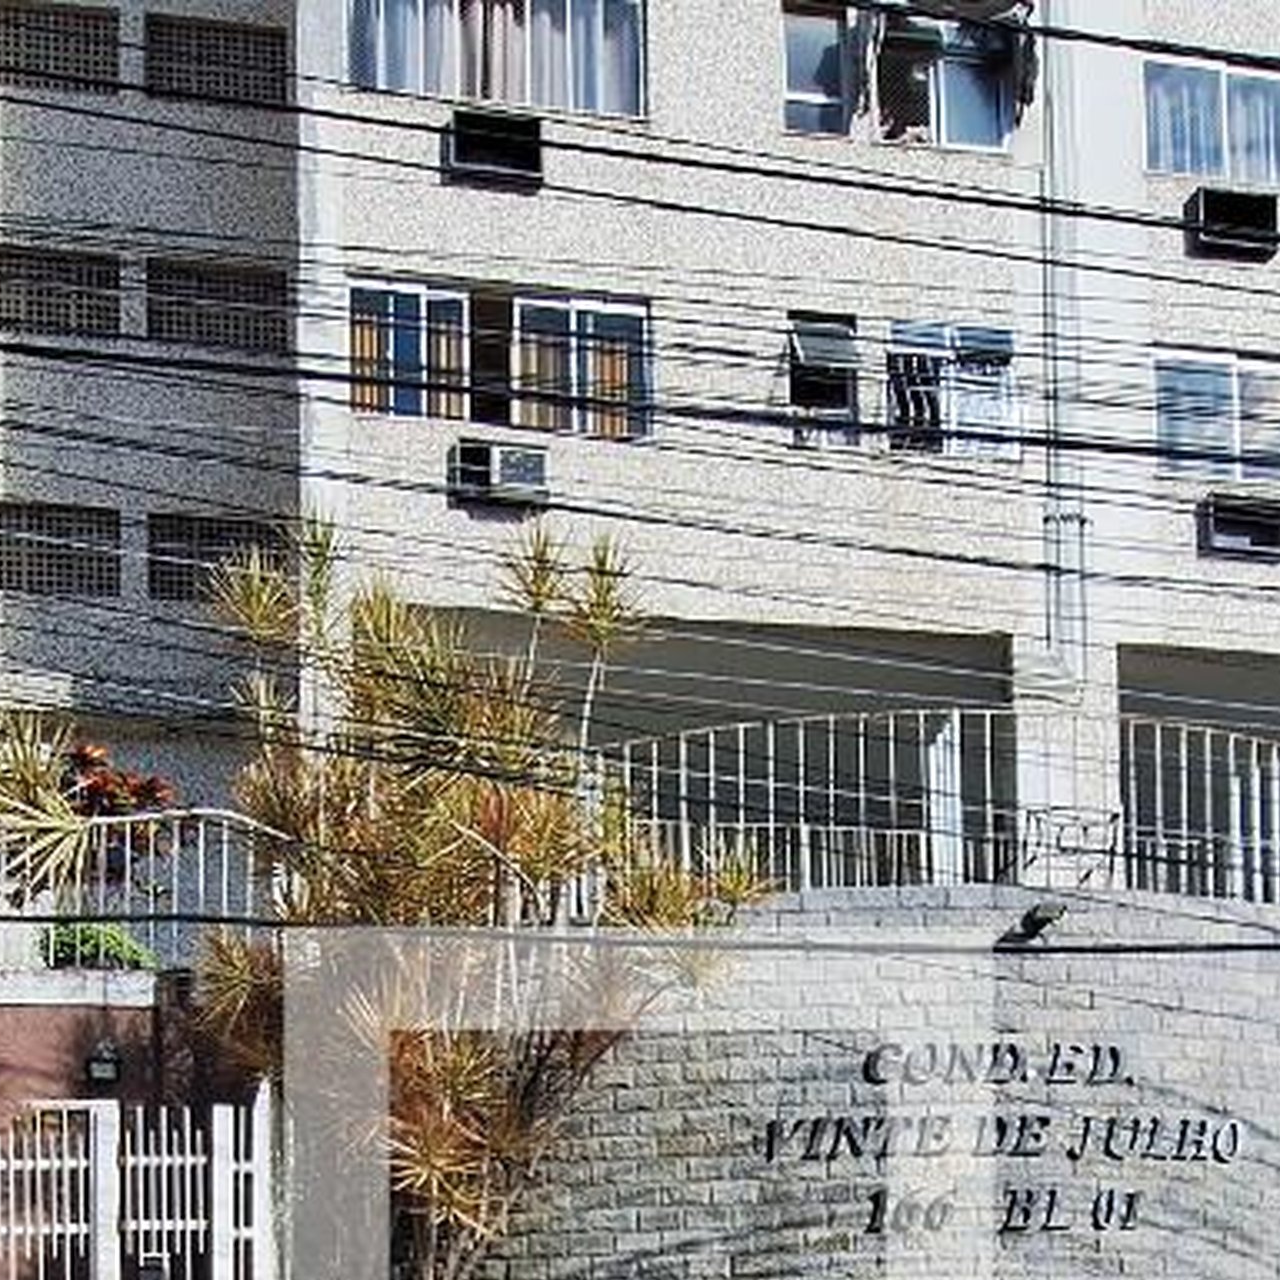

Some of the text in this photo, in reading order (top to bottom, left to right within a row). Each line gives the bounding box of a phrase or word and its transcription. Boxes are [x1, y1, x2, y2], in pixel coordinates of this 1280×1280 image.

[764, 1115, 1238, 1164] VINTE DE JULHO
[999, 1188, 1071, 1234] BL
